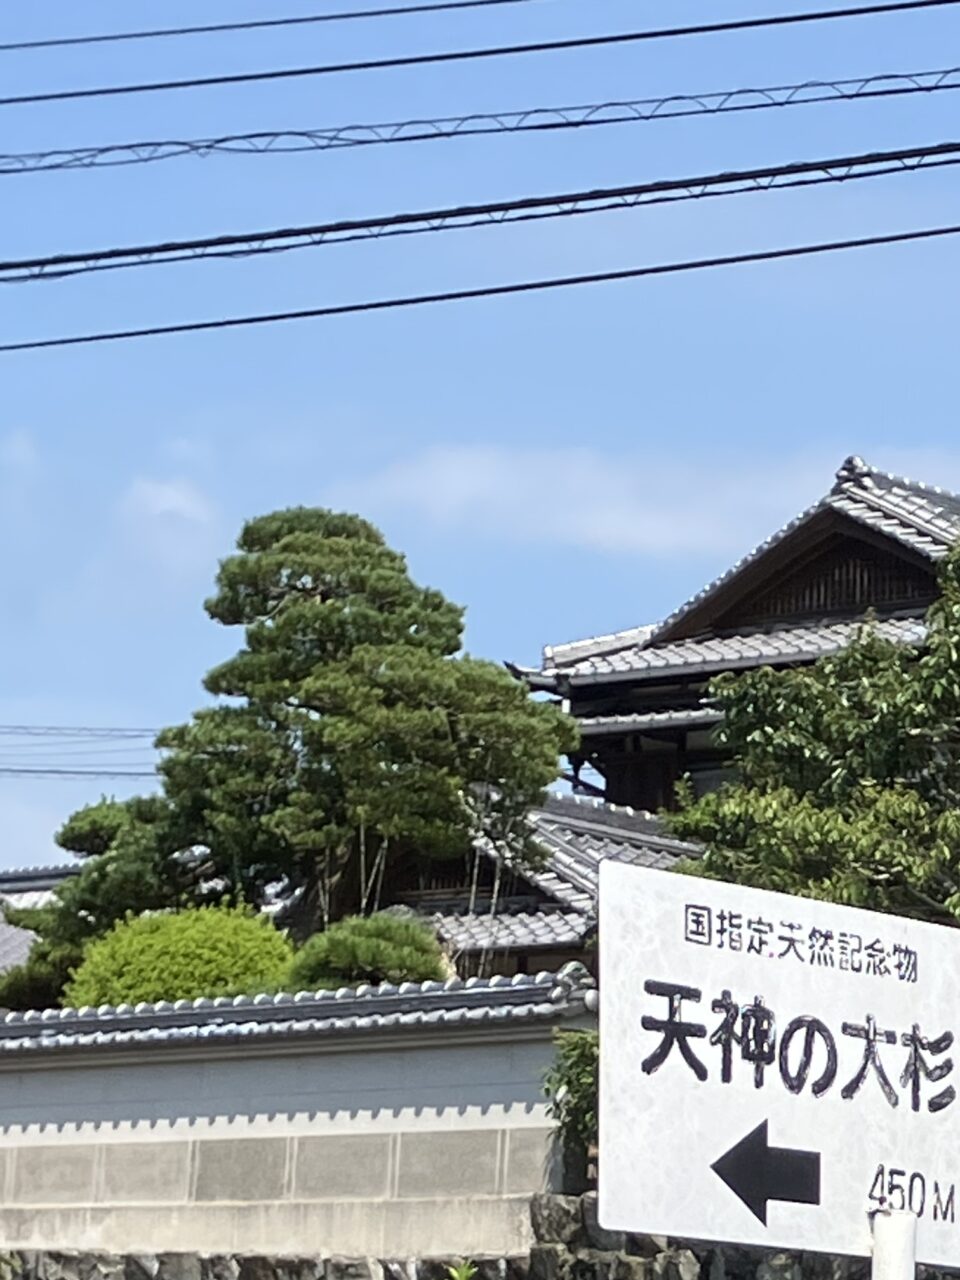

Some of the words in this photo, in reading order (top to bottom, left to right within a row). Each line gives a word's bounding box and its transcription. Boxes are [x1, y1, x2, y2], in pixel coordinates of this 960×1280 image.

[685, 903, 919, 983] 国指定天然記念物
[641, 979, 956, 1113] 天神の大杉
